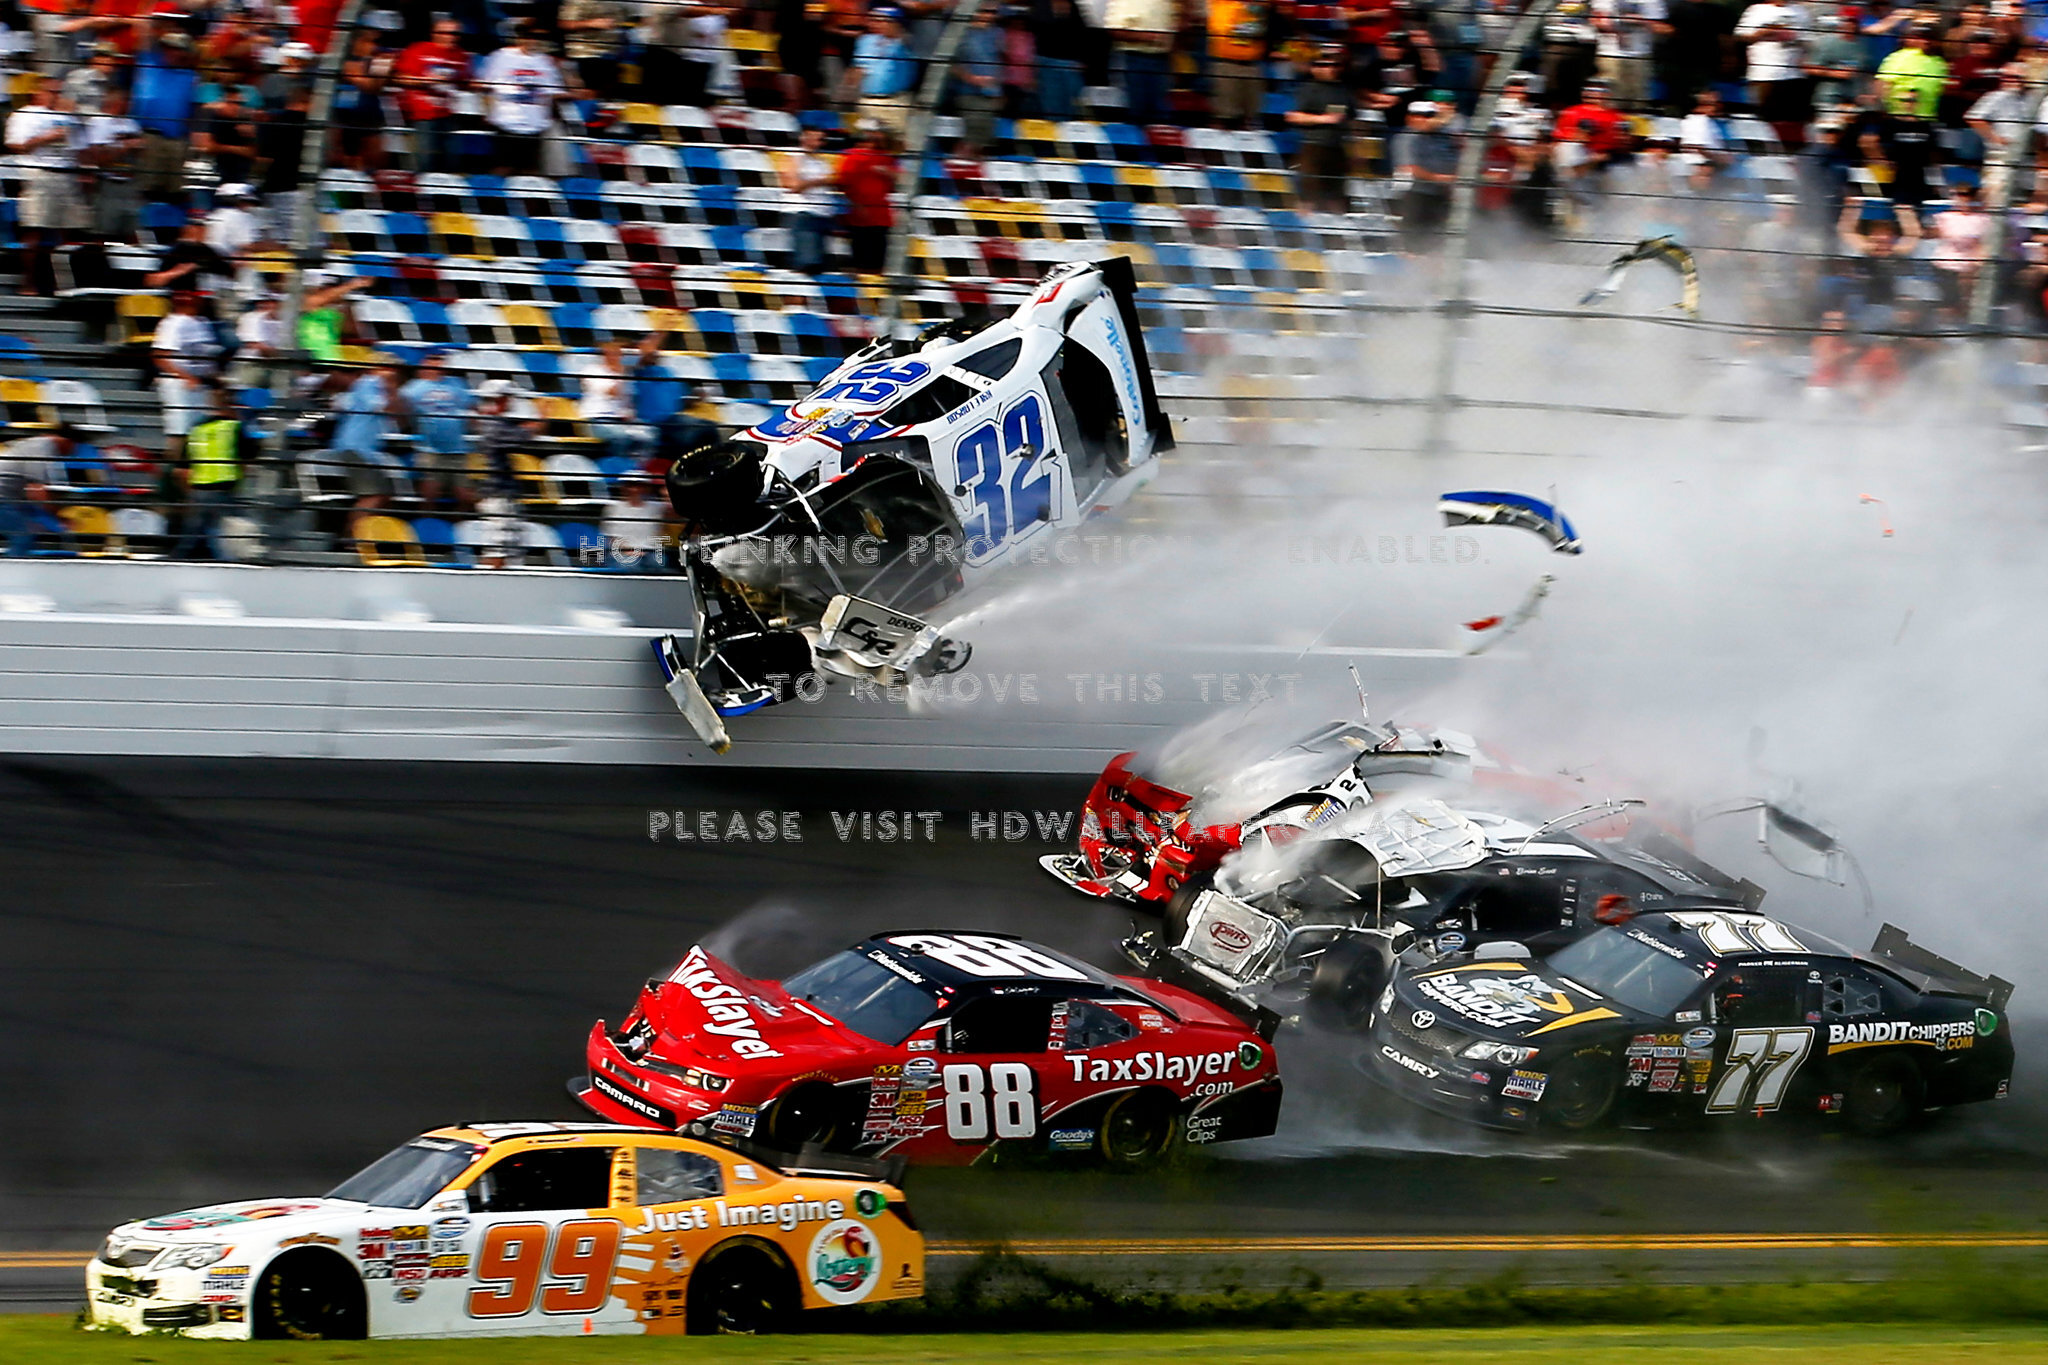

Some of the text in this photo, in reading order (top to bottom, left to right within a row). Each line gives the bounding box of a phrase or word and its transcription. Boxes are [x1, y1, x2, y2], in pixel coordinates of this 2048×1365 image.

[955, 391, 1057, 562] 32
[887, 616, 926, 633] DENSO
[1634, 931, 1687, 960] Nationwide
[876, 950, 925, 985] Nationwide
[1429, 973, 1542, 1024] BANDIT
[1064, 1049, 1236, 1087] TaxSlayer
[1381, 1045, 1440, 1079] CAMRY
[1513, 1068, 1547, 1081] MOOG
[1706, 1027, 1814, 1113] 77
[594, 1076, 660, 1118] CAMARO
[943, 1063, 1037, 1139] 88
[1508, 1077, 1544, 1091] MAHLE
[717, 1113, 756, 1127] MAHLE
[722, 1102, 758, 1115] MOOG
[1186, 1116, 1222, 1129] Great
[1050, 1129, 1095, 1142] Goody's
[1186, 1129, 1217, 1144] Clips
[637, 1195, 845, 1233] Just Imagine
[466, 1218, 624, 1318] 99
